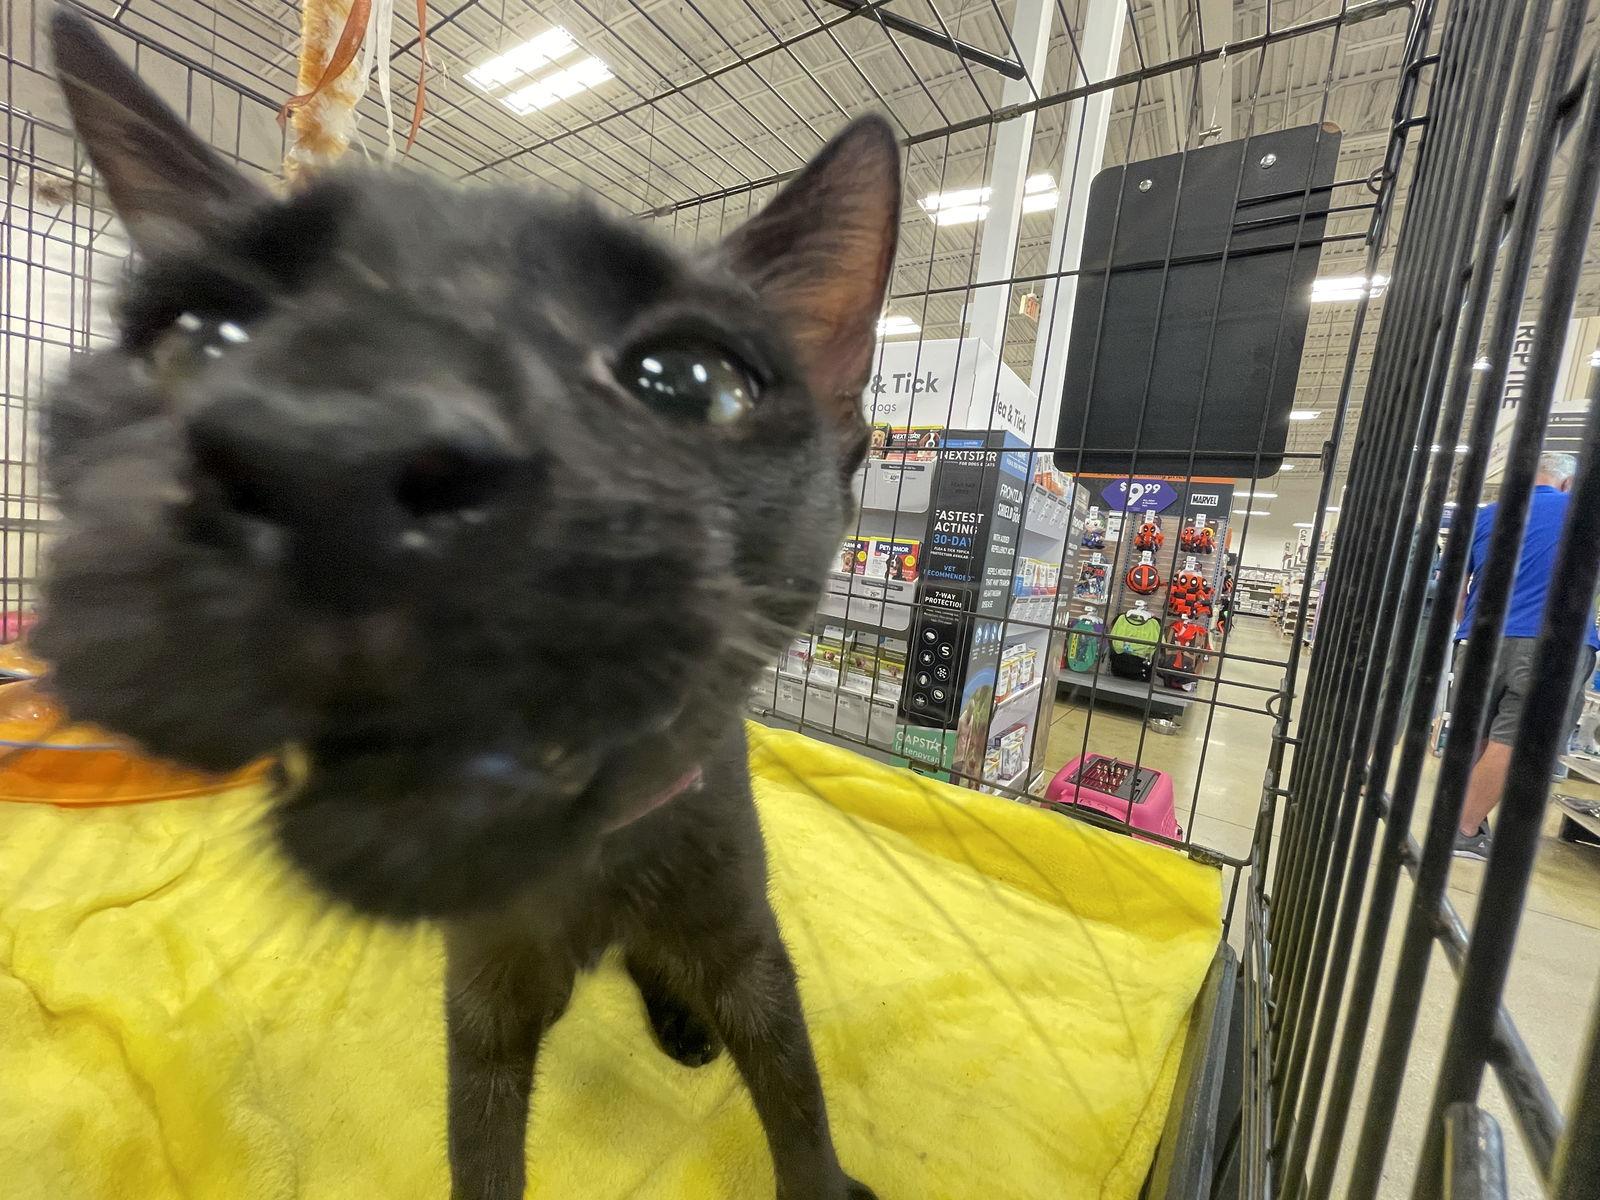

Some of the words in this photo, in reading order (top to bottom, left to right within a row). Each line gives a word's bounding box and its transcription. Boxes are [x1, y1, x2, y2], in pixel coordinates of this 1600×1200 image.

[870, 374, 887, 394] &
[892, 372, 939, 394] Tick
[1007, 404, 1013, 424] &
[1013, 408, 1027, 434] Tick
[1192, 496, 1218, 505] MARVEL
[935, 591, 956, 600] 7-WAY
